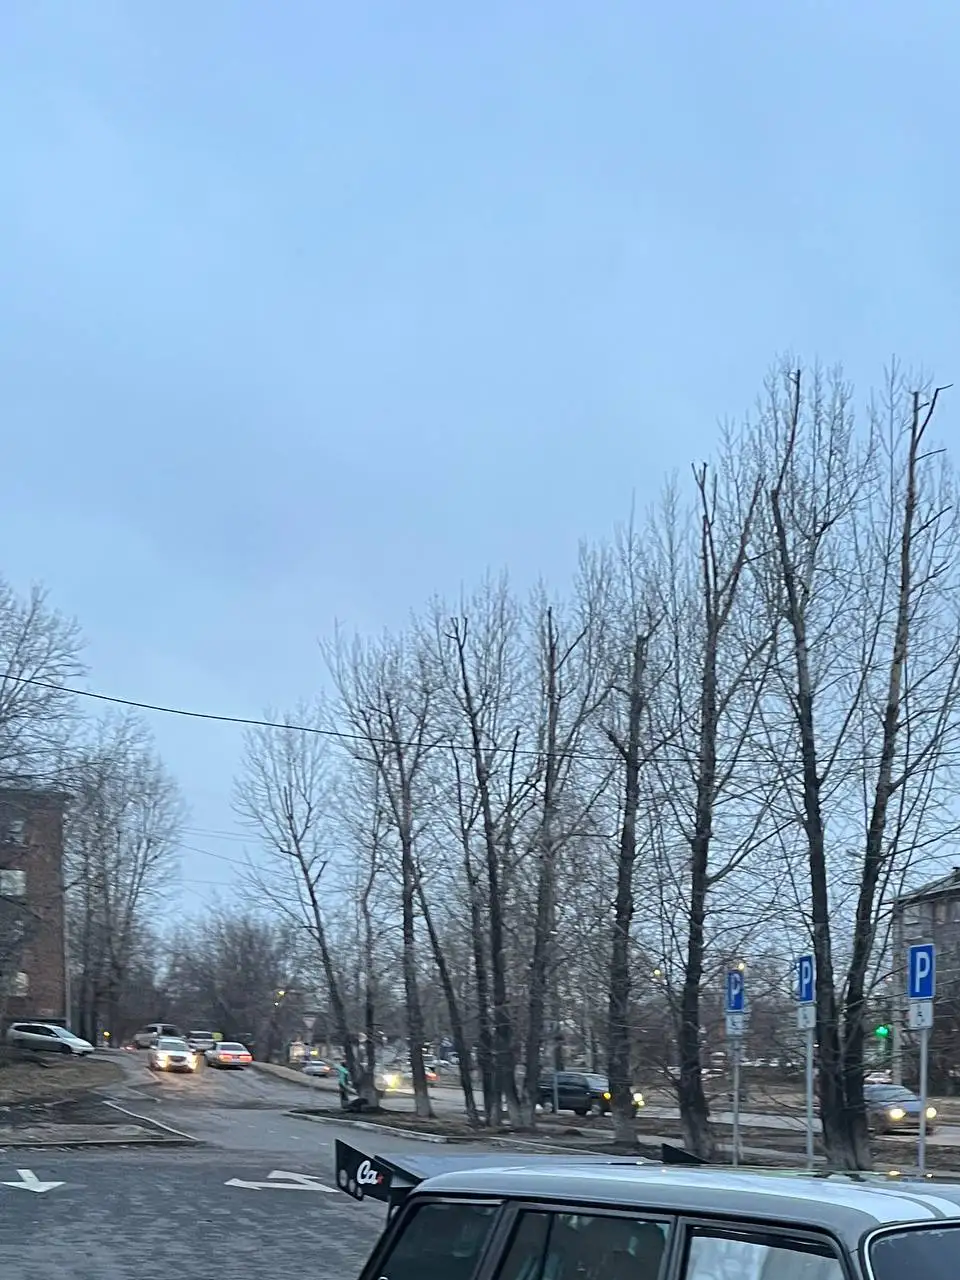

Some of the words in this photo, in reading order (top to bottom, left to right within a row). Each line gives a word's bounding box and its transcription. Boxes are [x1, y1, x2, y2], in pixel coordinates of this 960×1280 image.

[730, 972, 741, 1007] P
[801, 960, 812, 998] P
[915, 951, 930, 993] P
